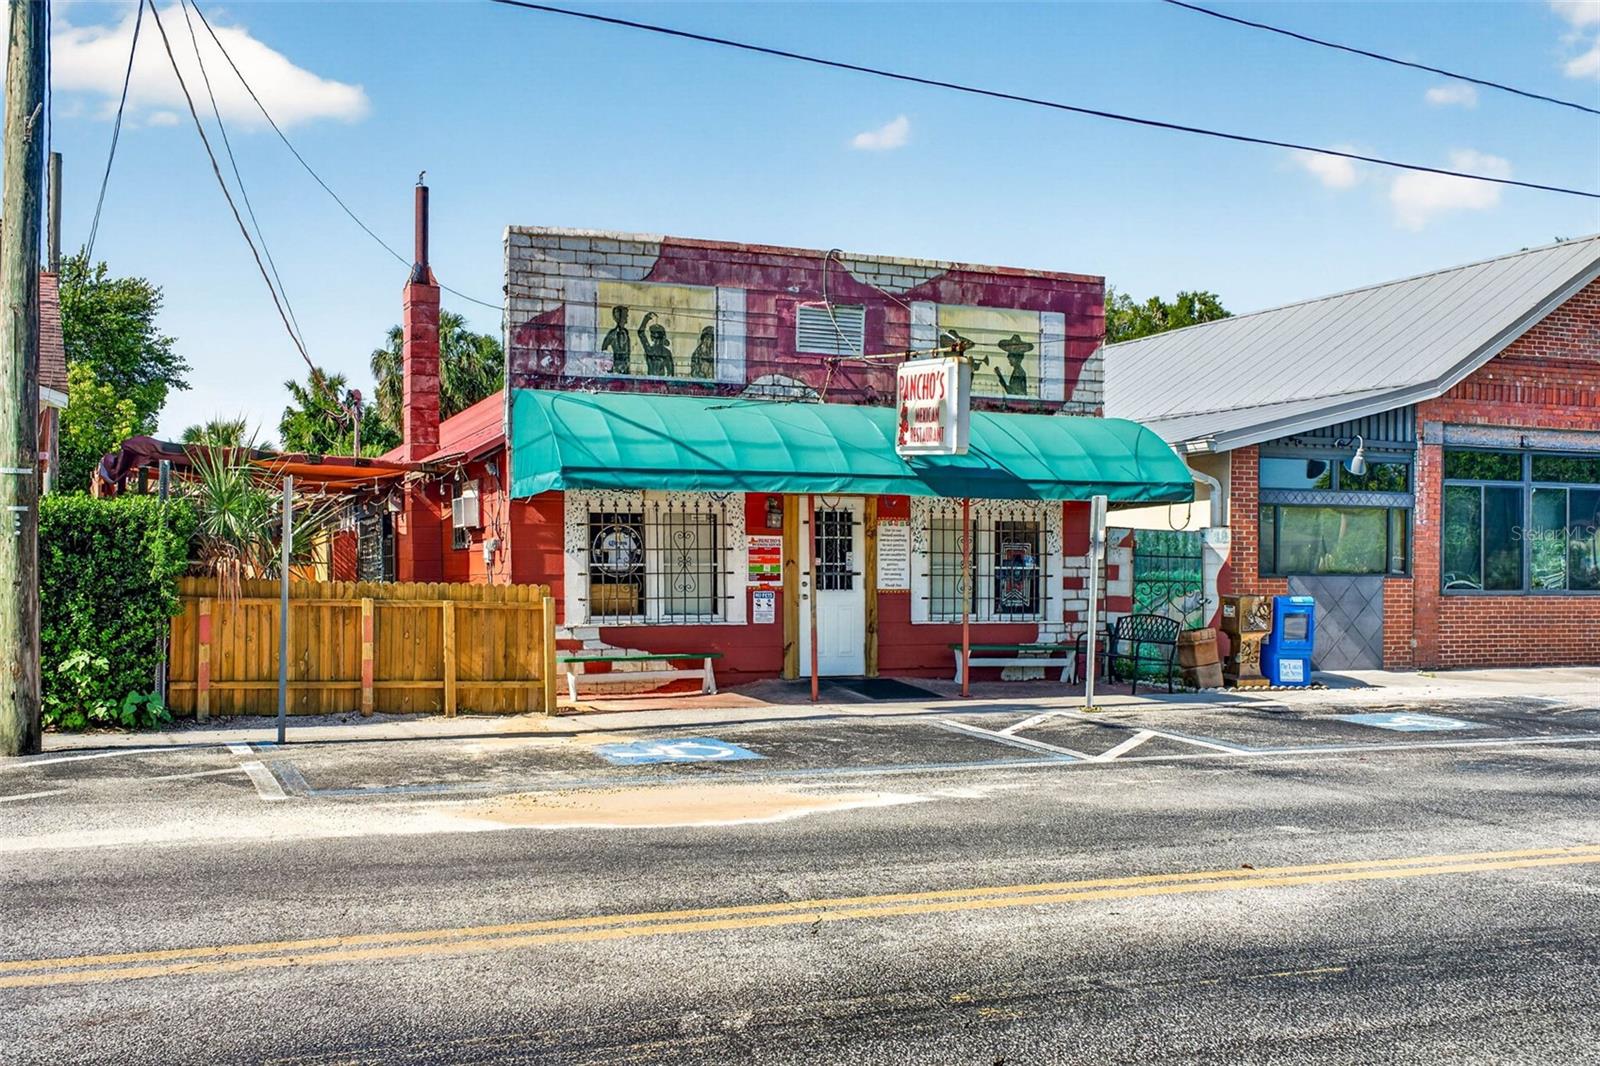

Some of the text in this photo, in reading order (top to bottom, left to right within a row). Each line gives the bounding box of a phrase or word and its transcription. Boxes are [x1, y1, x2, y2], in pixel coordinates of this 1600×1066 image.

[900, 370, 945, 401] PANCHO'S
[915, 407, 940, 423] MEXICAN
[910, 426, 945, 443] RESTAURANT
